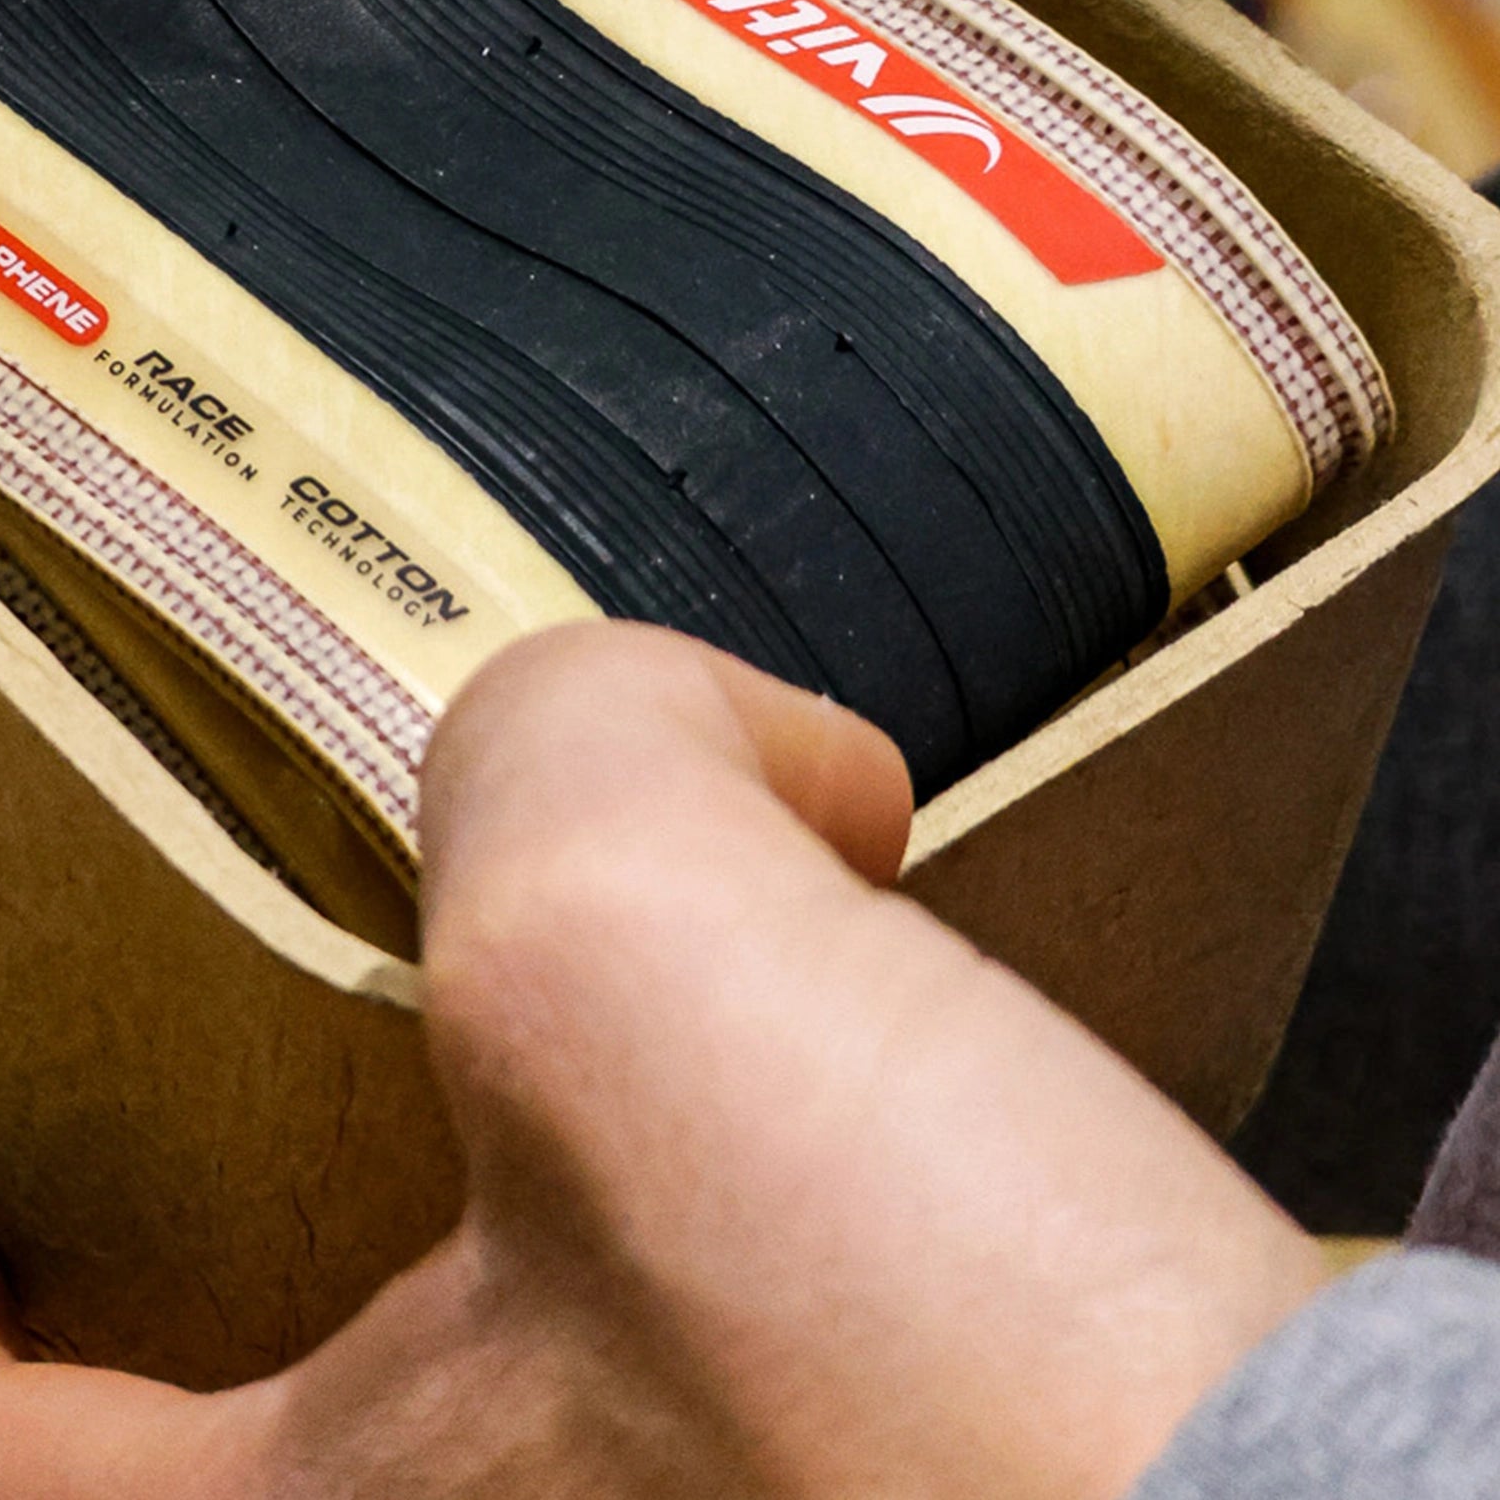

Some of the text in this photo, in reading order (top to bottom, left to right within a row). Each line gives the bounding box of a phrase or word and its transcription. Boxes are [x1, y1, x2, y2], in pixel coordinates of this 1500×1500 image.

[93, 348, 259, 482] FORMULATION
[133, 349, 255, 442] RACE
[279, 494, 437, 628] TECHNOLOGY
[288, 474, 471, 622] COTTON
